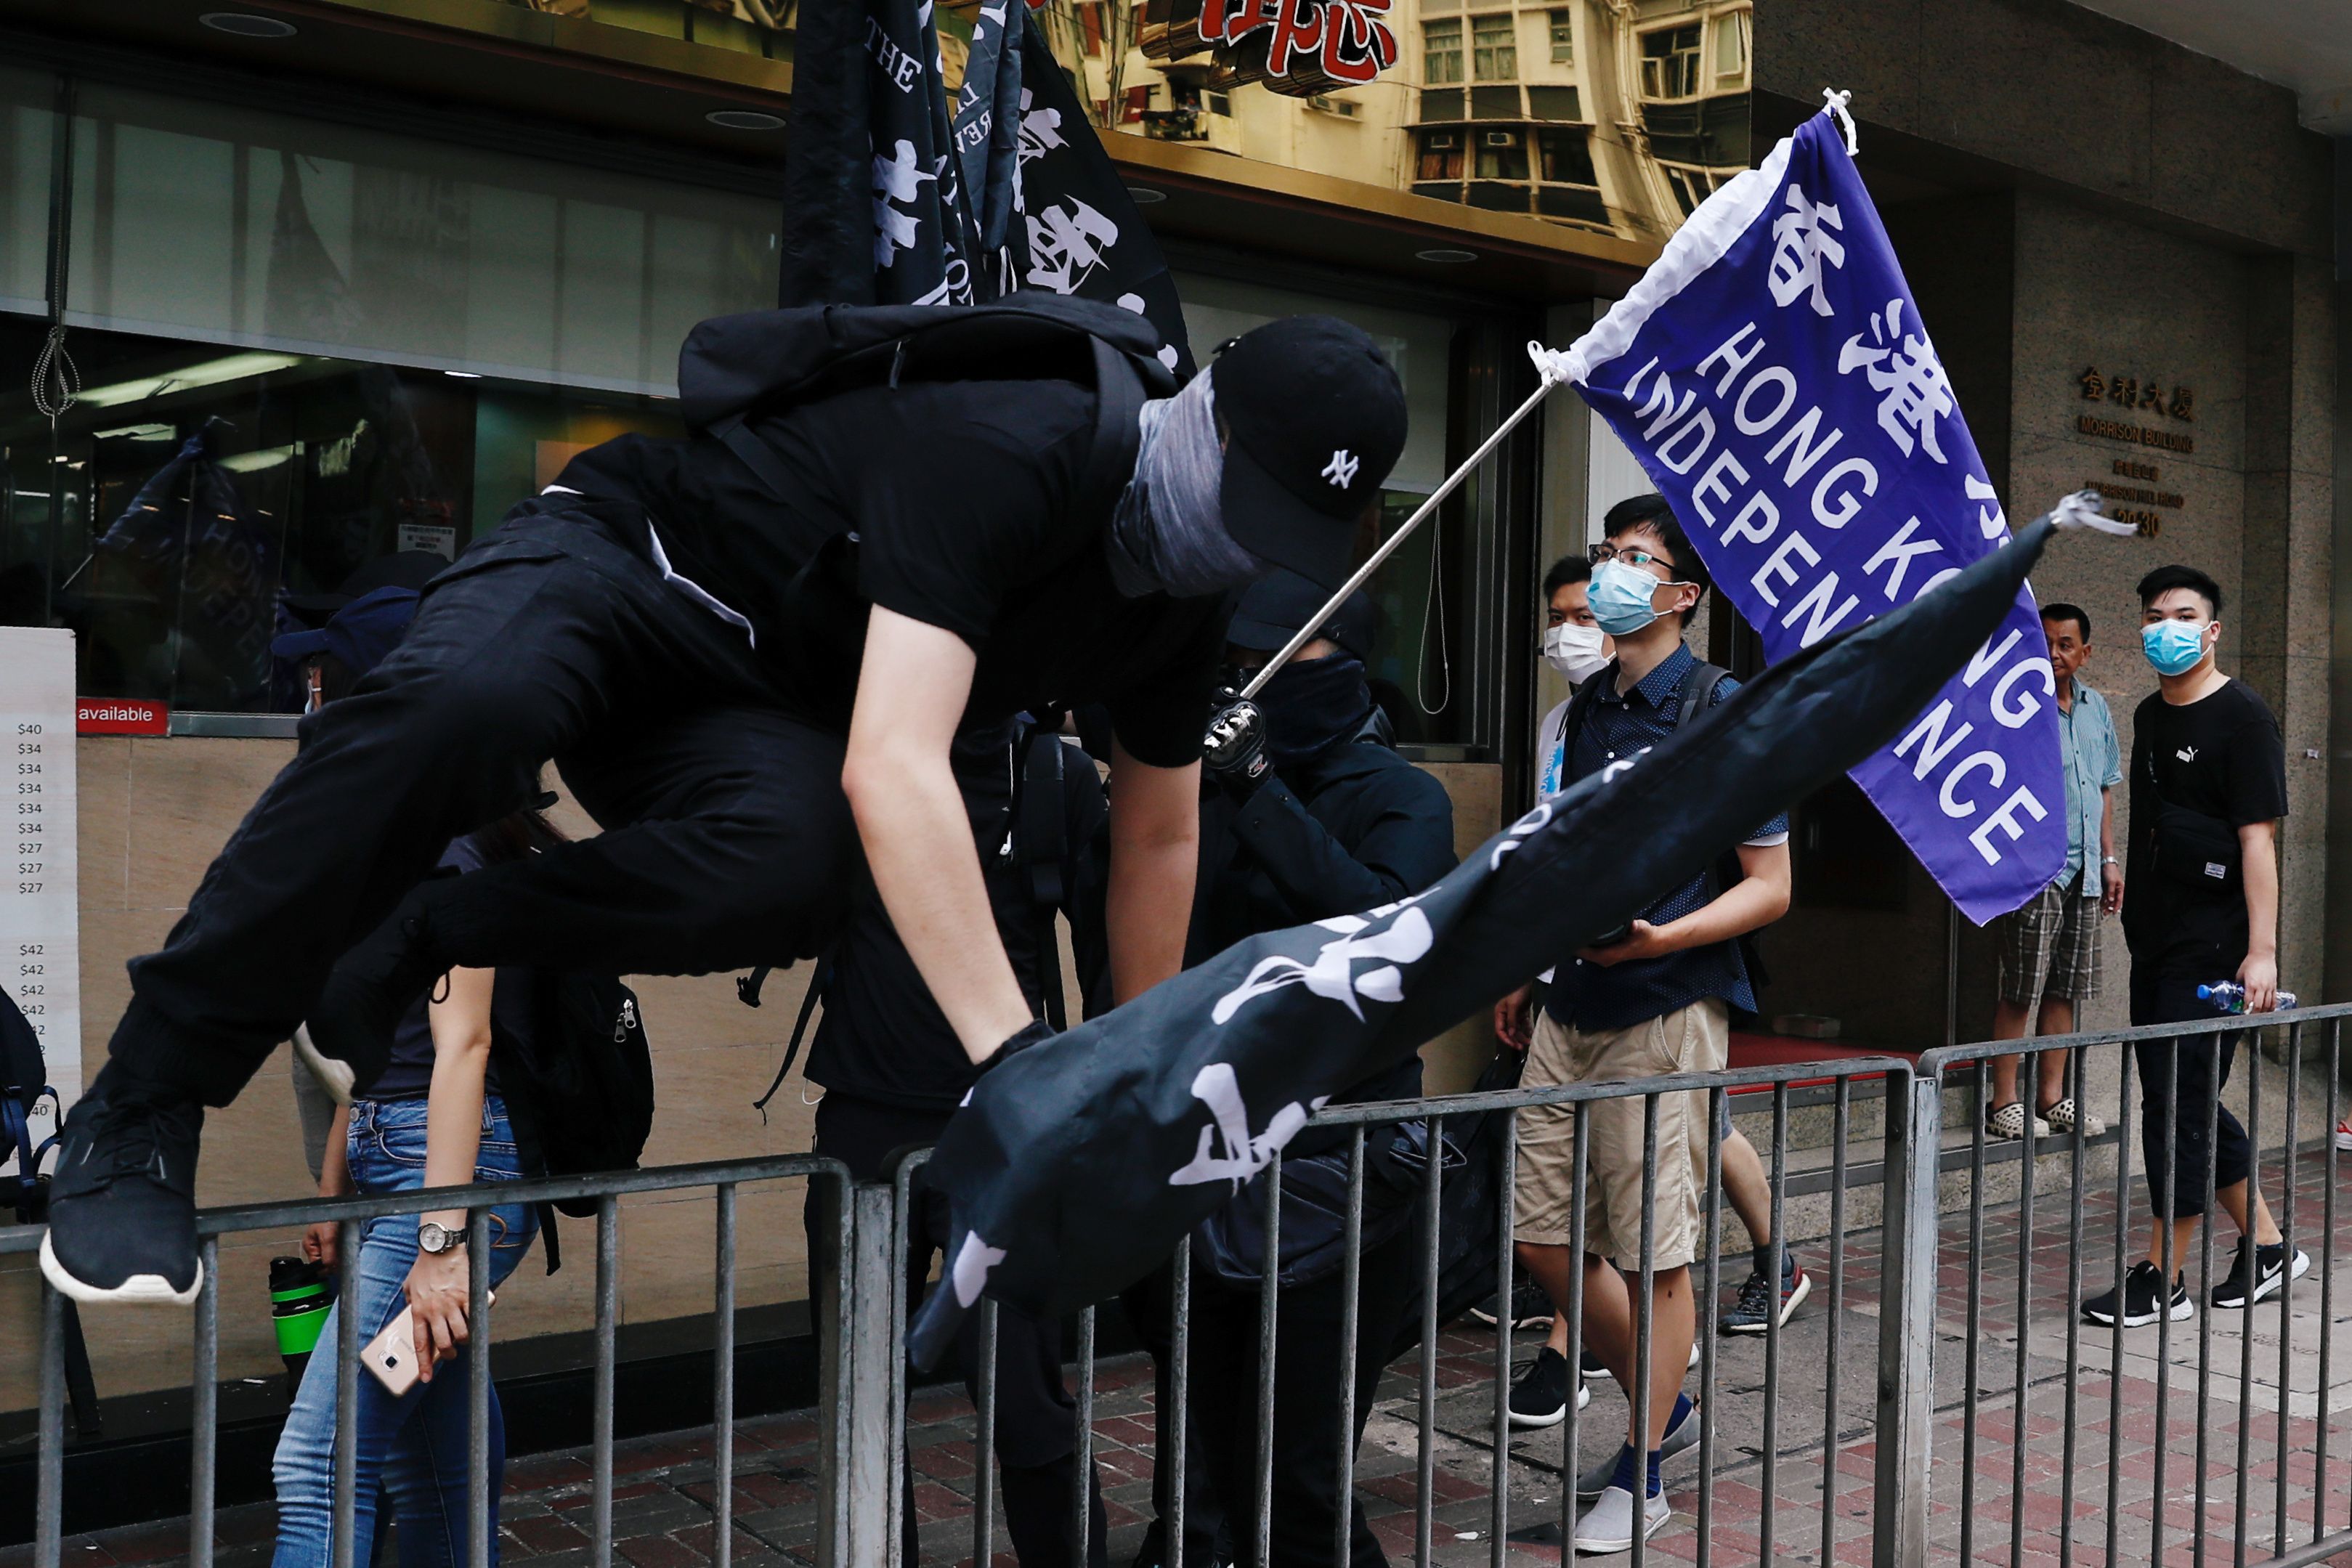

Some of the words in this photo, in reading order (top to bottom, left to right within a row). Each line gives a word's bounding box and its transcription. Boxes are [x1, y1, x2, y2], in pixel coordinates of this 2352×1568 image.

[1695, 320, 1879, 529] HONG
[2080, 416, 2140, 442] MORRISON
[2145, 430, 2194, 455] BUILDING
[1622, 355, 2049, 866] INDEPENNCE
[78, 707, 153, 722] available
[18, 723, 41, 735] $40
[18, 743, 41, 755] $34
[18, 763, 41, 774] $34
[18, 783, 41, 795] $34
[18, 803, 42, 814] $34
[18, 822, 42, 834] $34
[19, 842, 42, 854] $27
[19, 863, 43, 874] $27
[19, 882, 43, 894] $27
[20, 944, 44, 956] $42
[20, 964, 44, 976] $42
[20, 984, 45, 996] $42
[31, 1105, 48, 1116] 40
